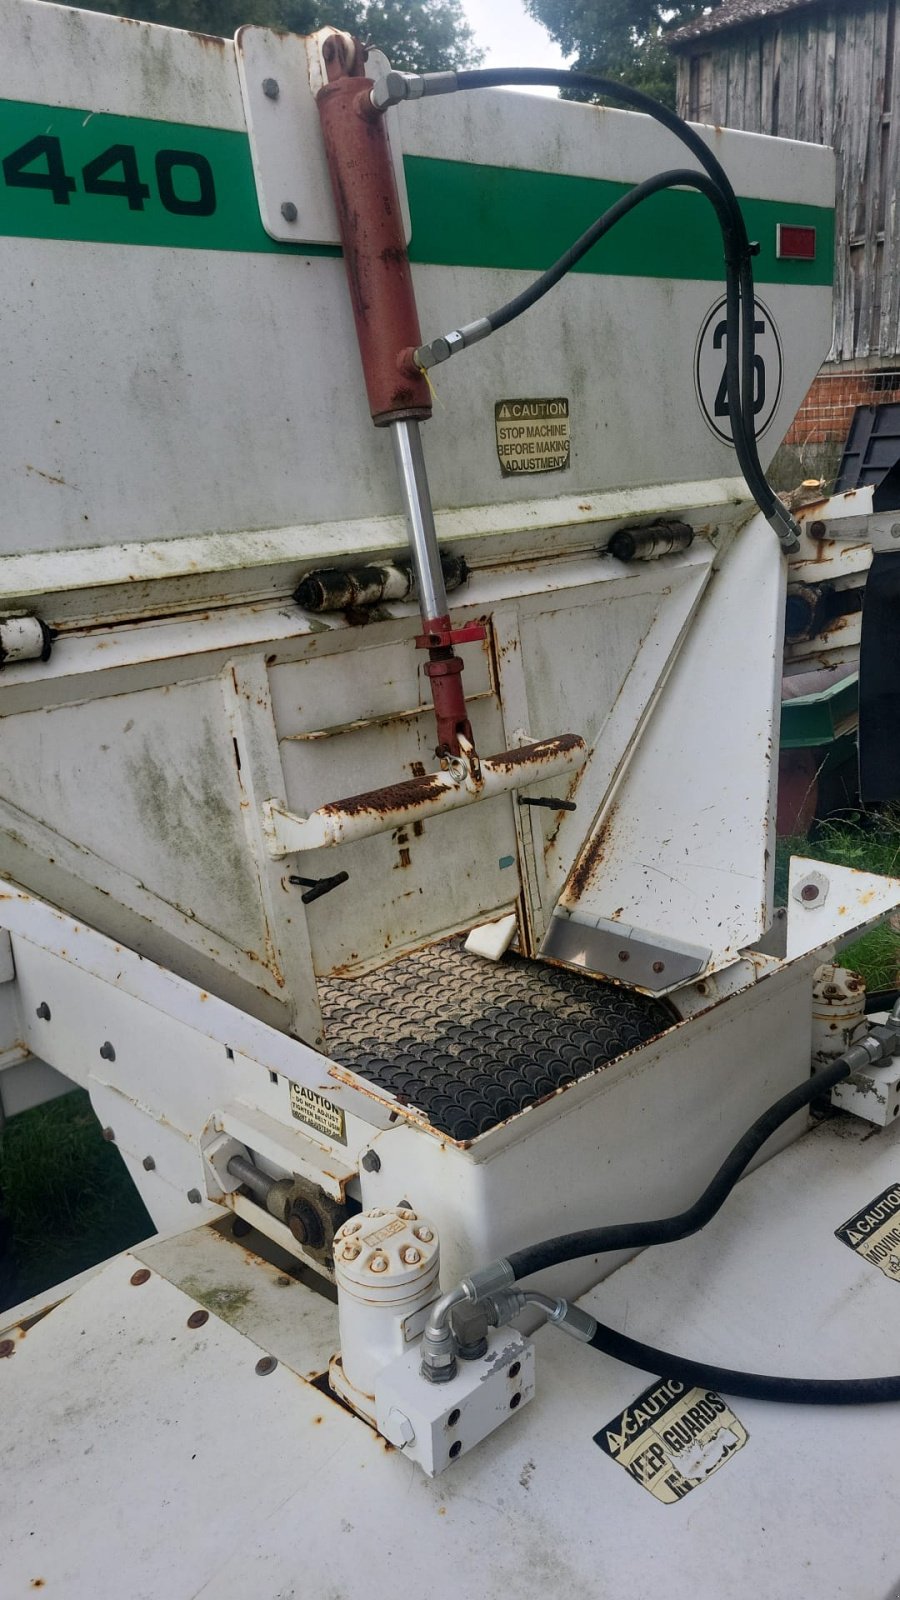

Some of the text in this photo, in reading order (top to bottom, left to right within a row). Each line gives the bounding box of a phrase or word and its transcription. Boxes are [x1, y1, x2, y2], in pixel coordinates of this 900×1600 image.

[2, 134, 217, 217] 440
[512, 402, 567, 417] CAUTION
[499, 424, 567, 440] STOP MACHINE
[498, 439, 570, 456] BEFORE MAKING
[505, 455, 565, 471] ADJUSTMENT
[293, 1083, 339, 1115] CAUTION
[295, 1096, 339, 1124] DO NOT ADJUST
[291, 1101, 341, 1131] TIGHTEN BELT USIN
[624, 1379, 684, 1434] CAUTIO
[629, 1442, 666, 1482] KEEP
[662, 1391, 726, 1453] GUARDS
